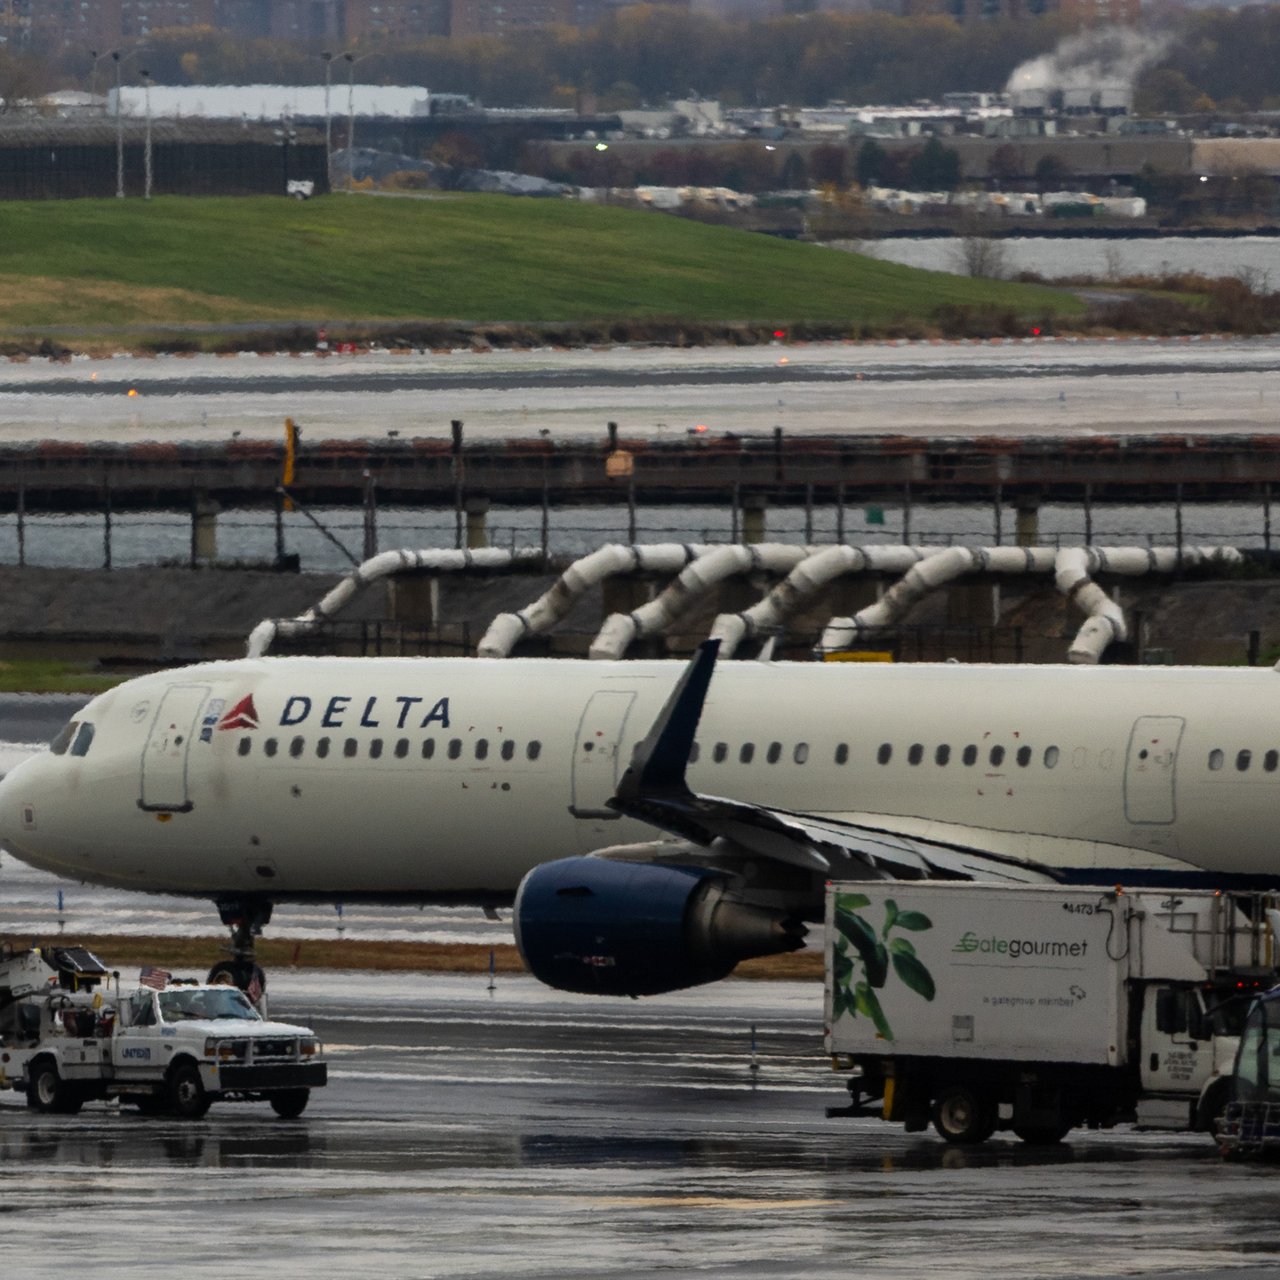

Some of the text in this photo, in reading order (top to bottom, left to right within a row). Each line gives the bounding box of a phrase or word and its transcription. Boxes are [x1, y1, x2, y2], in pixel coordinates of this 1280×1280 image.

[279, 696, 451, 728] DELTA
[1038, 997, 1074, 1007] member
[122, 1047, 145, 1059] UNITED
